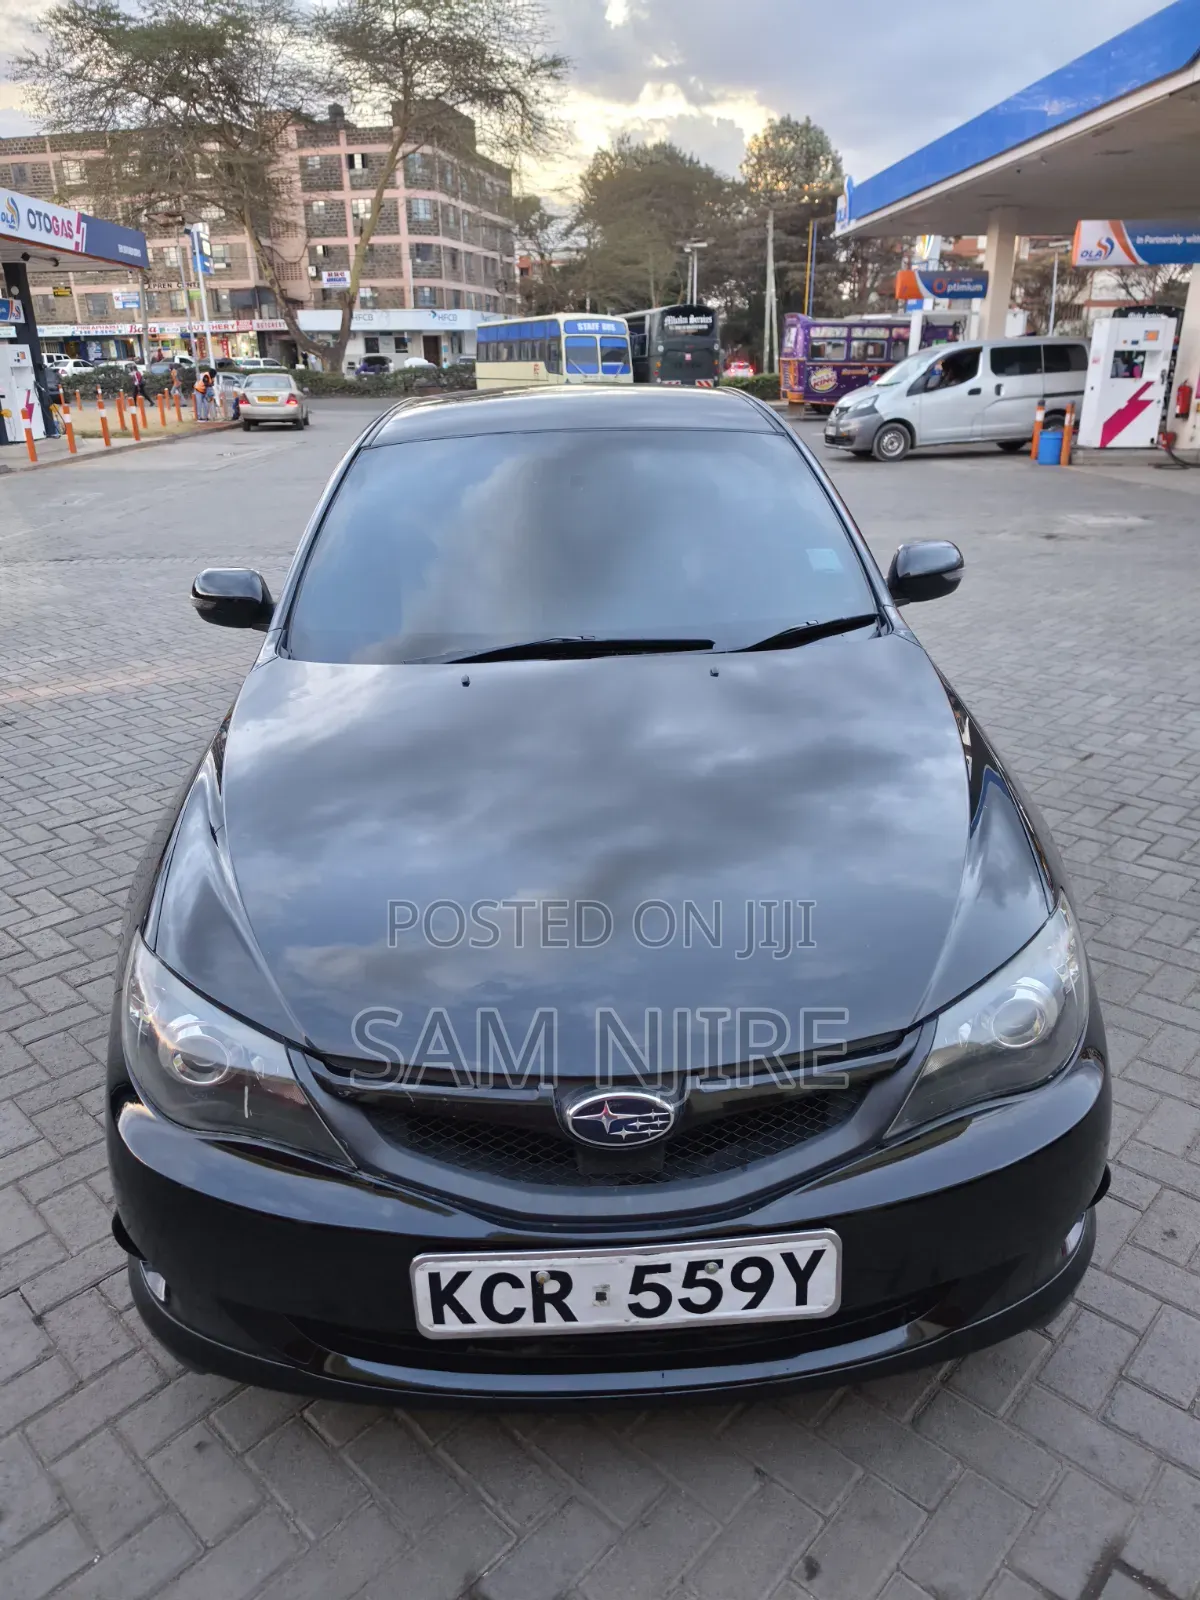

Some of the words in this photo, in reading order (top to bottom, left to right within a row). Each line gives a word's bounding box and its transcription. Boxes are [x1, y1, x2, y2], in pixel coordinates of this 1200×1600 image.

[27, 208, 74, 240] OTOGAS
[1144, 233, 1184, 246] Partnership
[1080, 249, 1103, 259] OLA
[128, 324, 157, 333] Baa
[427, 1270, 579, 1325] KCR
[627, 1249, 827, 1319] 559Y
